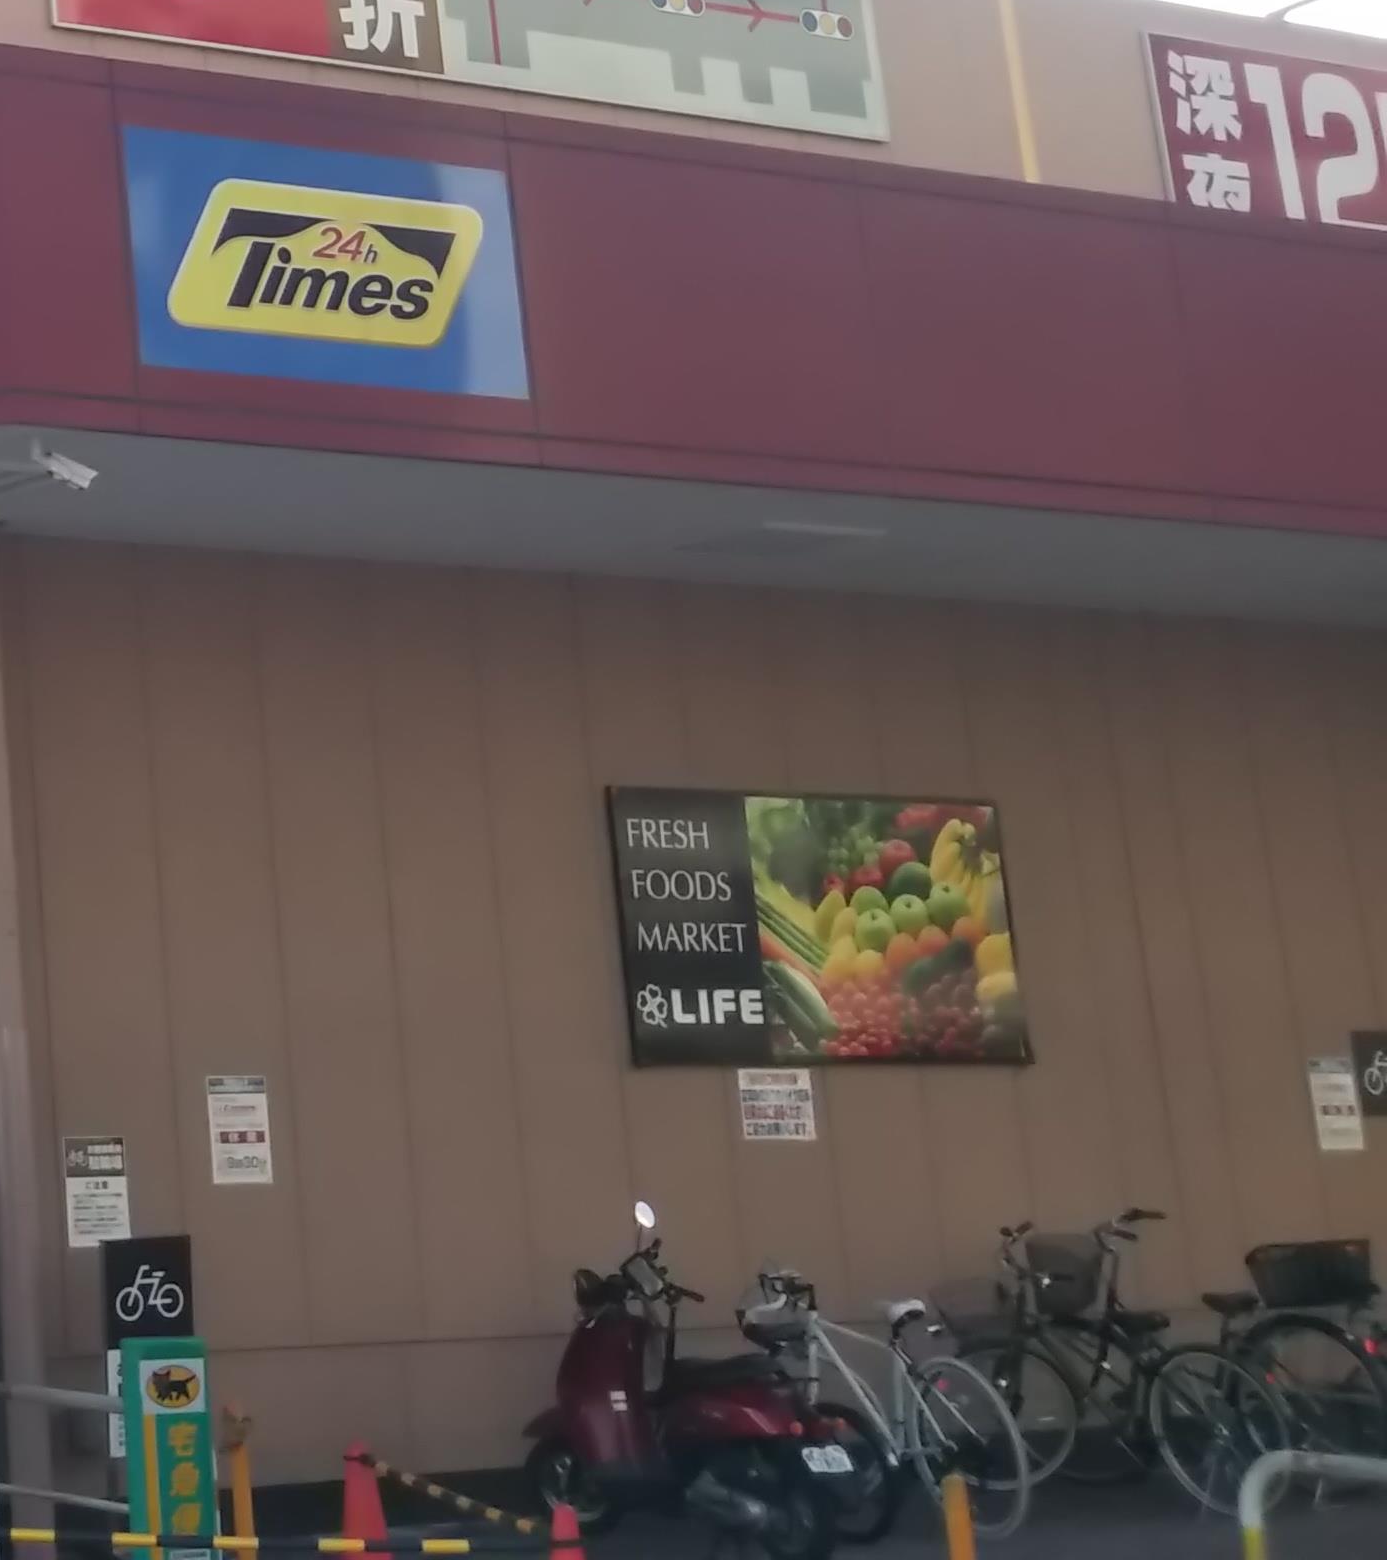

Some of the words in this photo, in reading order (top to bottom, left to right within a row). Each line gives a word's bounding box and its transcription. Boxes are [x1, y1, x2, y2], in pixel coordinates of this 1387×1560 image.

[1243, 61, 1386, 225] 12
[227, 239, 434, 321] Times
[627, 818, 710, 850] FRESH
[632, 869, 732, 902] FOODS
[638, 922, 748, 954] MARKET
[671, 989, 766, 1025] LIFE
